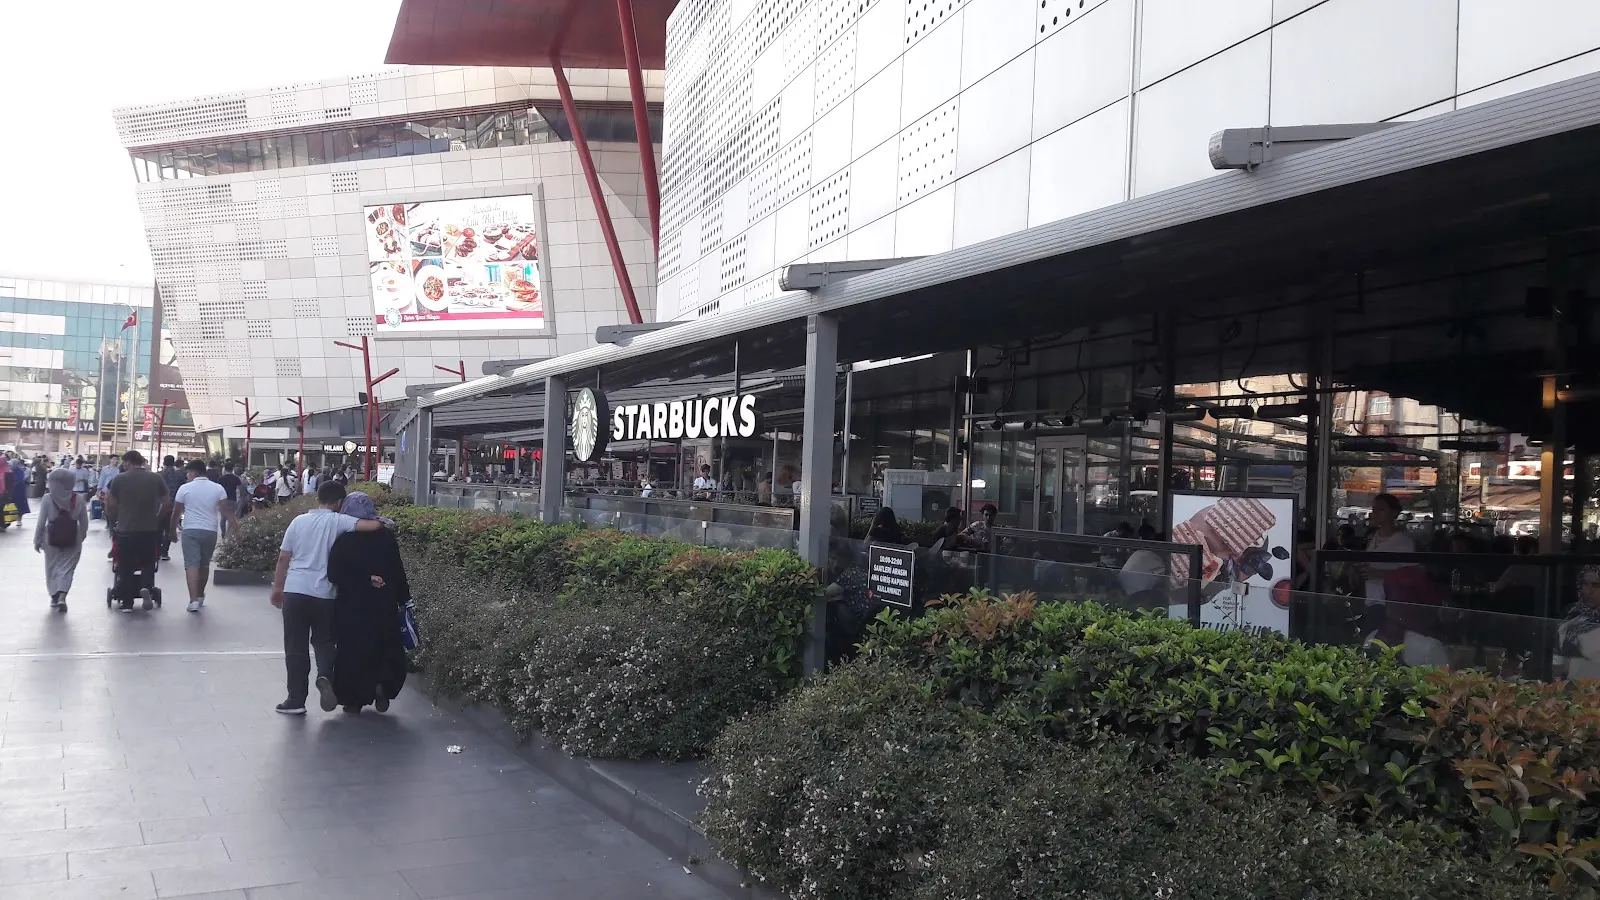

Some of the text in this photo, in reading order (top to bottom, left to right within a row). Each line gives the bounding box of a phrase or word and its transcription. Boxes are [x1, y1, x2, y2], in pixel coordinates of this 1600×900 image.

[613, 394, 756, 440] STARBUCKS
[21, 420, 94, 431] ALTUN MOLYA
[871, 574, 880, 582] ANA
[880, 574, 891, 585] GİRİŞ
